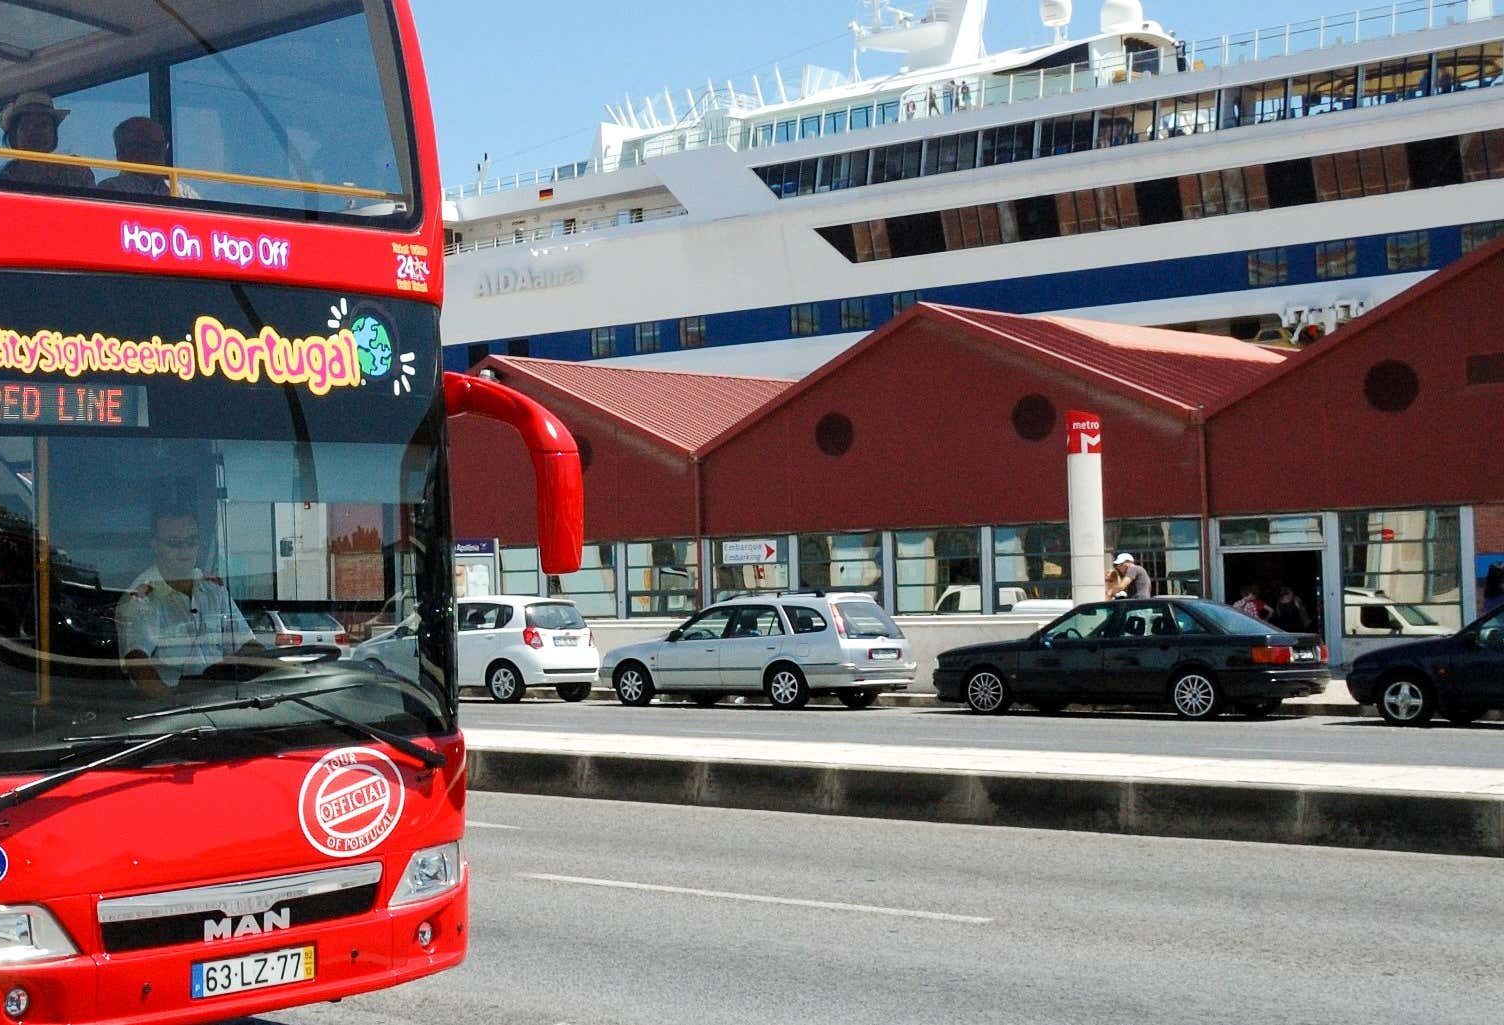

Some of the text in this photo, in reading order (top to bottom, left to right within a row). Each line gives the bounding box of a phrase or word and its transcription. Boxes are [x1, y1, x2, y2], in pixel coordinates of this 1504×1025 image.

[122, 223, 289, 267] Hop On Hop Off
[396, 254, 414, 279] 24
[195, 315, 361, 396] Portugal
[58, 387, 123, 423] LINE
[1072, 420, 1100, 430] metro
[323, 753, 357, 775] TOUR
[320, 780, 387, 821] OFFICIAL
[326, 812, 394, 850] OF PORTUGAL
[204, 907, 291, 944] MAN
